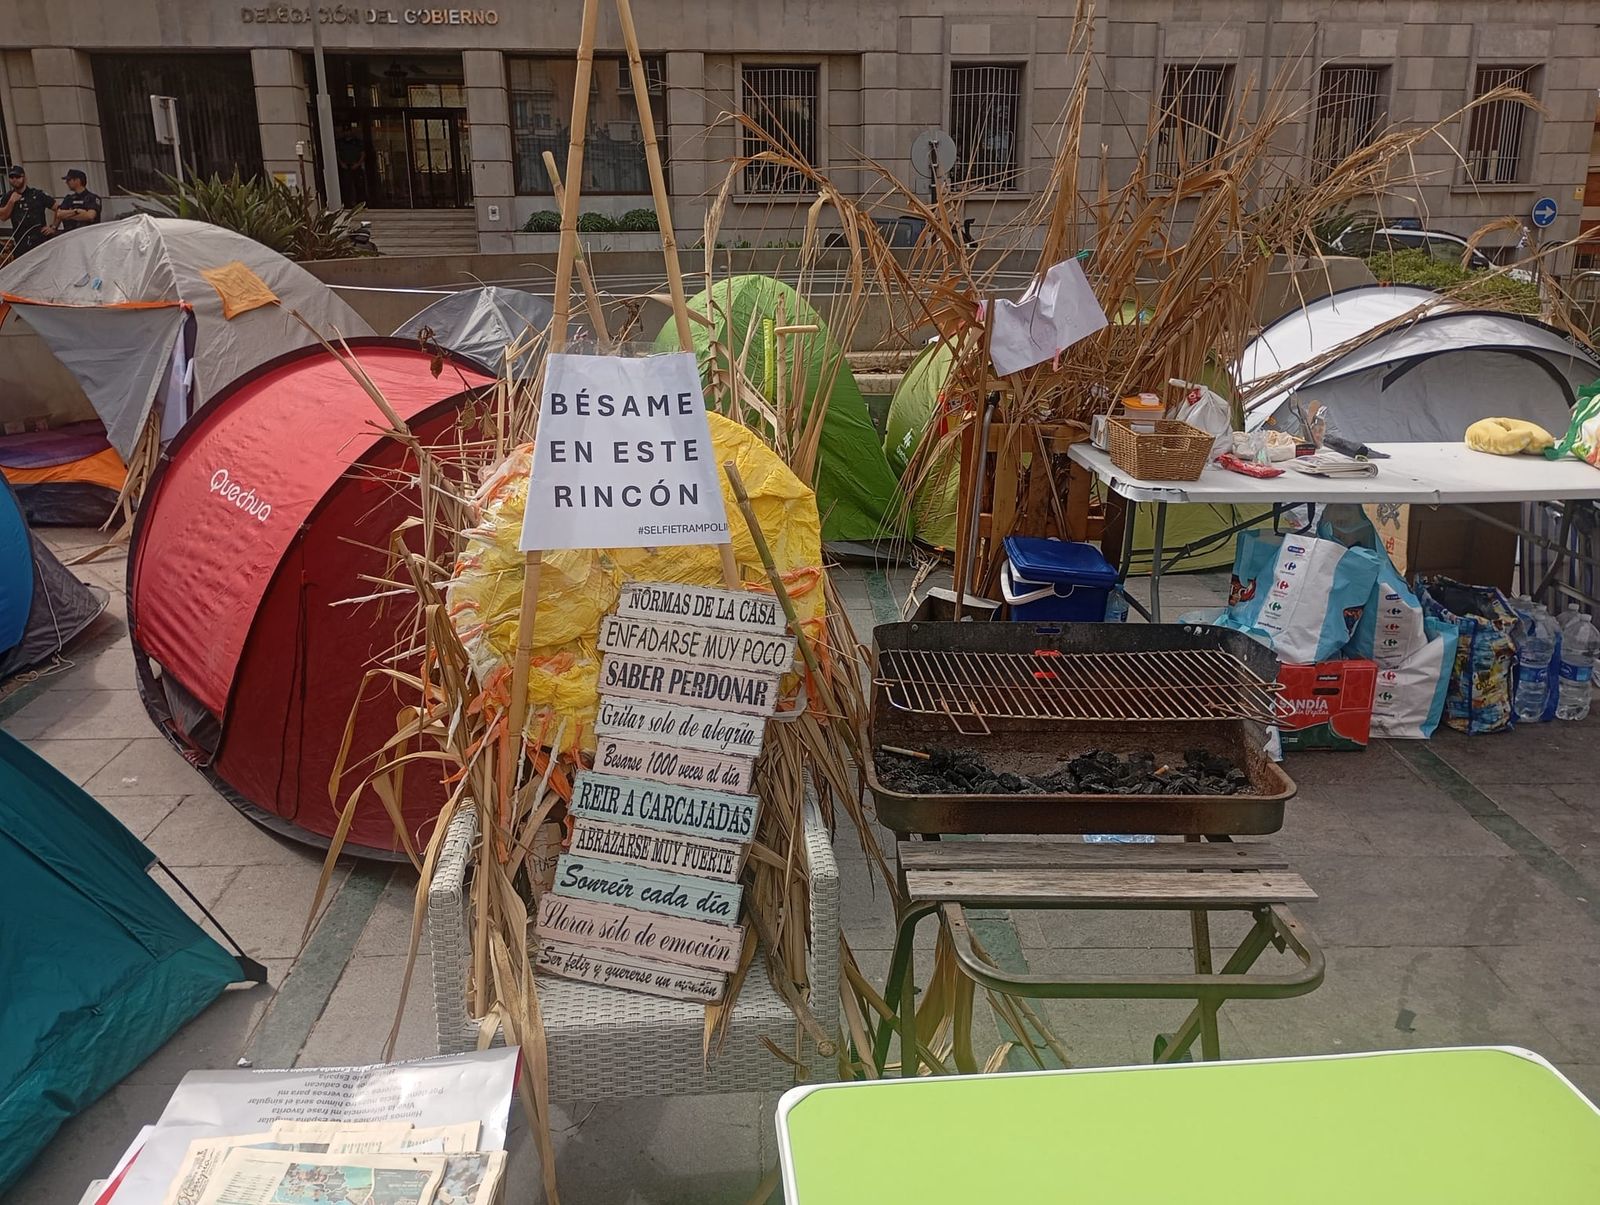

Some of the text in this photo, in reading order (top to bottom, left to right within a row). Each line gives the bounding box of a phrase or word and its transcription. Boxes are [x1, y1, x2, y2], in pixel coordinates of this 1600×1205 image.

[366, 8, 398, 25] DEL
[404, 8, 499, 25] GOBIERNO
[551, 388, 693, 417] BÉSAME
[550, 439, 699, 464] EN ESTE
[210, 468, 272, 522] Quechua
[554, 479, 699, 508] RINCÓN
[638, 522, 729, 535] #SELFIETRAMPOLI
[628, 586, 777, 625] NORMAS DE LA CASA
[606, 621, 787, 667] ENFADARSE MUY POCO
[606, 660, 769, 707] SABER PERDONAR
[1280, 696, 1329, 710] SANDÍA
[601, 702, 755, 750] Gritar solo de alegría
[603, 743, 741, 787] Besarse 1000 veces al día
[578, 781, 753, 836] REIR A CARCAJADAS
[576, 827, 734, 875] ABRAZARSE MUY FUERTE
[560, 863, 731, 916] Sonreír cada día
[539, 900, 731, 962] Llorar sólo de emoción
[540, 945, 562, 967] Ser
[562, 951, 591, 977] feliz
[593, 963, 603, 979] y
[605, 964, 652, 982] quererse
[654, 976, 671, 988] un
[290, 1089, 312, 1097] para
[304, 1080, 341, 1089] caducan
[312, 1090, 341, 1098] versos
[247, 1097, 284, 1107] singular
[271, 1106, 304, 1115] favorita
[284, 1097, 293, 1105] el
[306, 1107, 329, 1115] frase
[316, 1099, 344, 1108] himno
